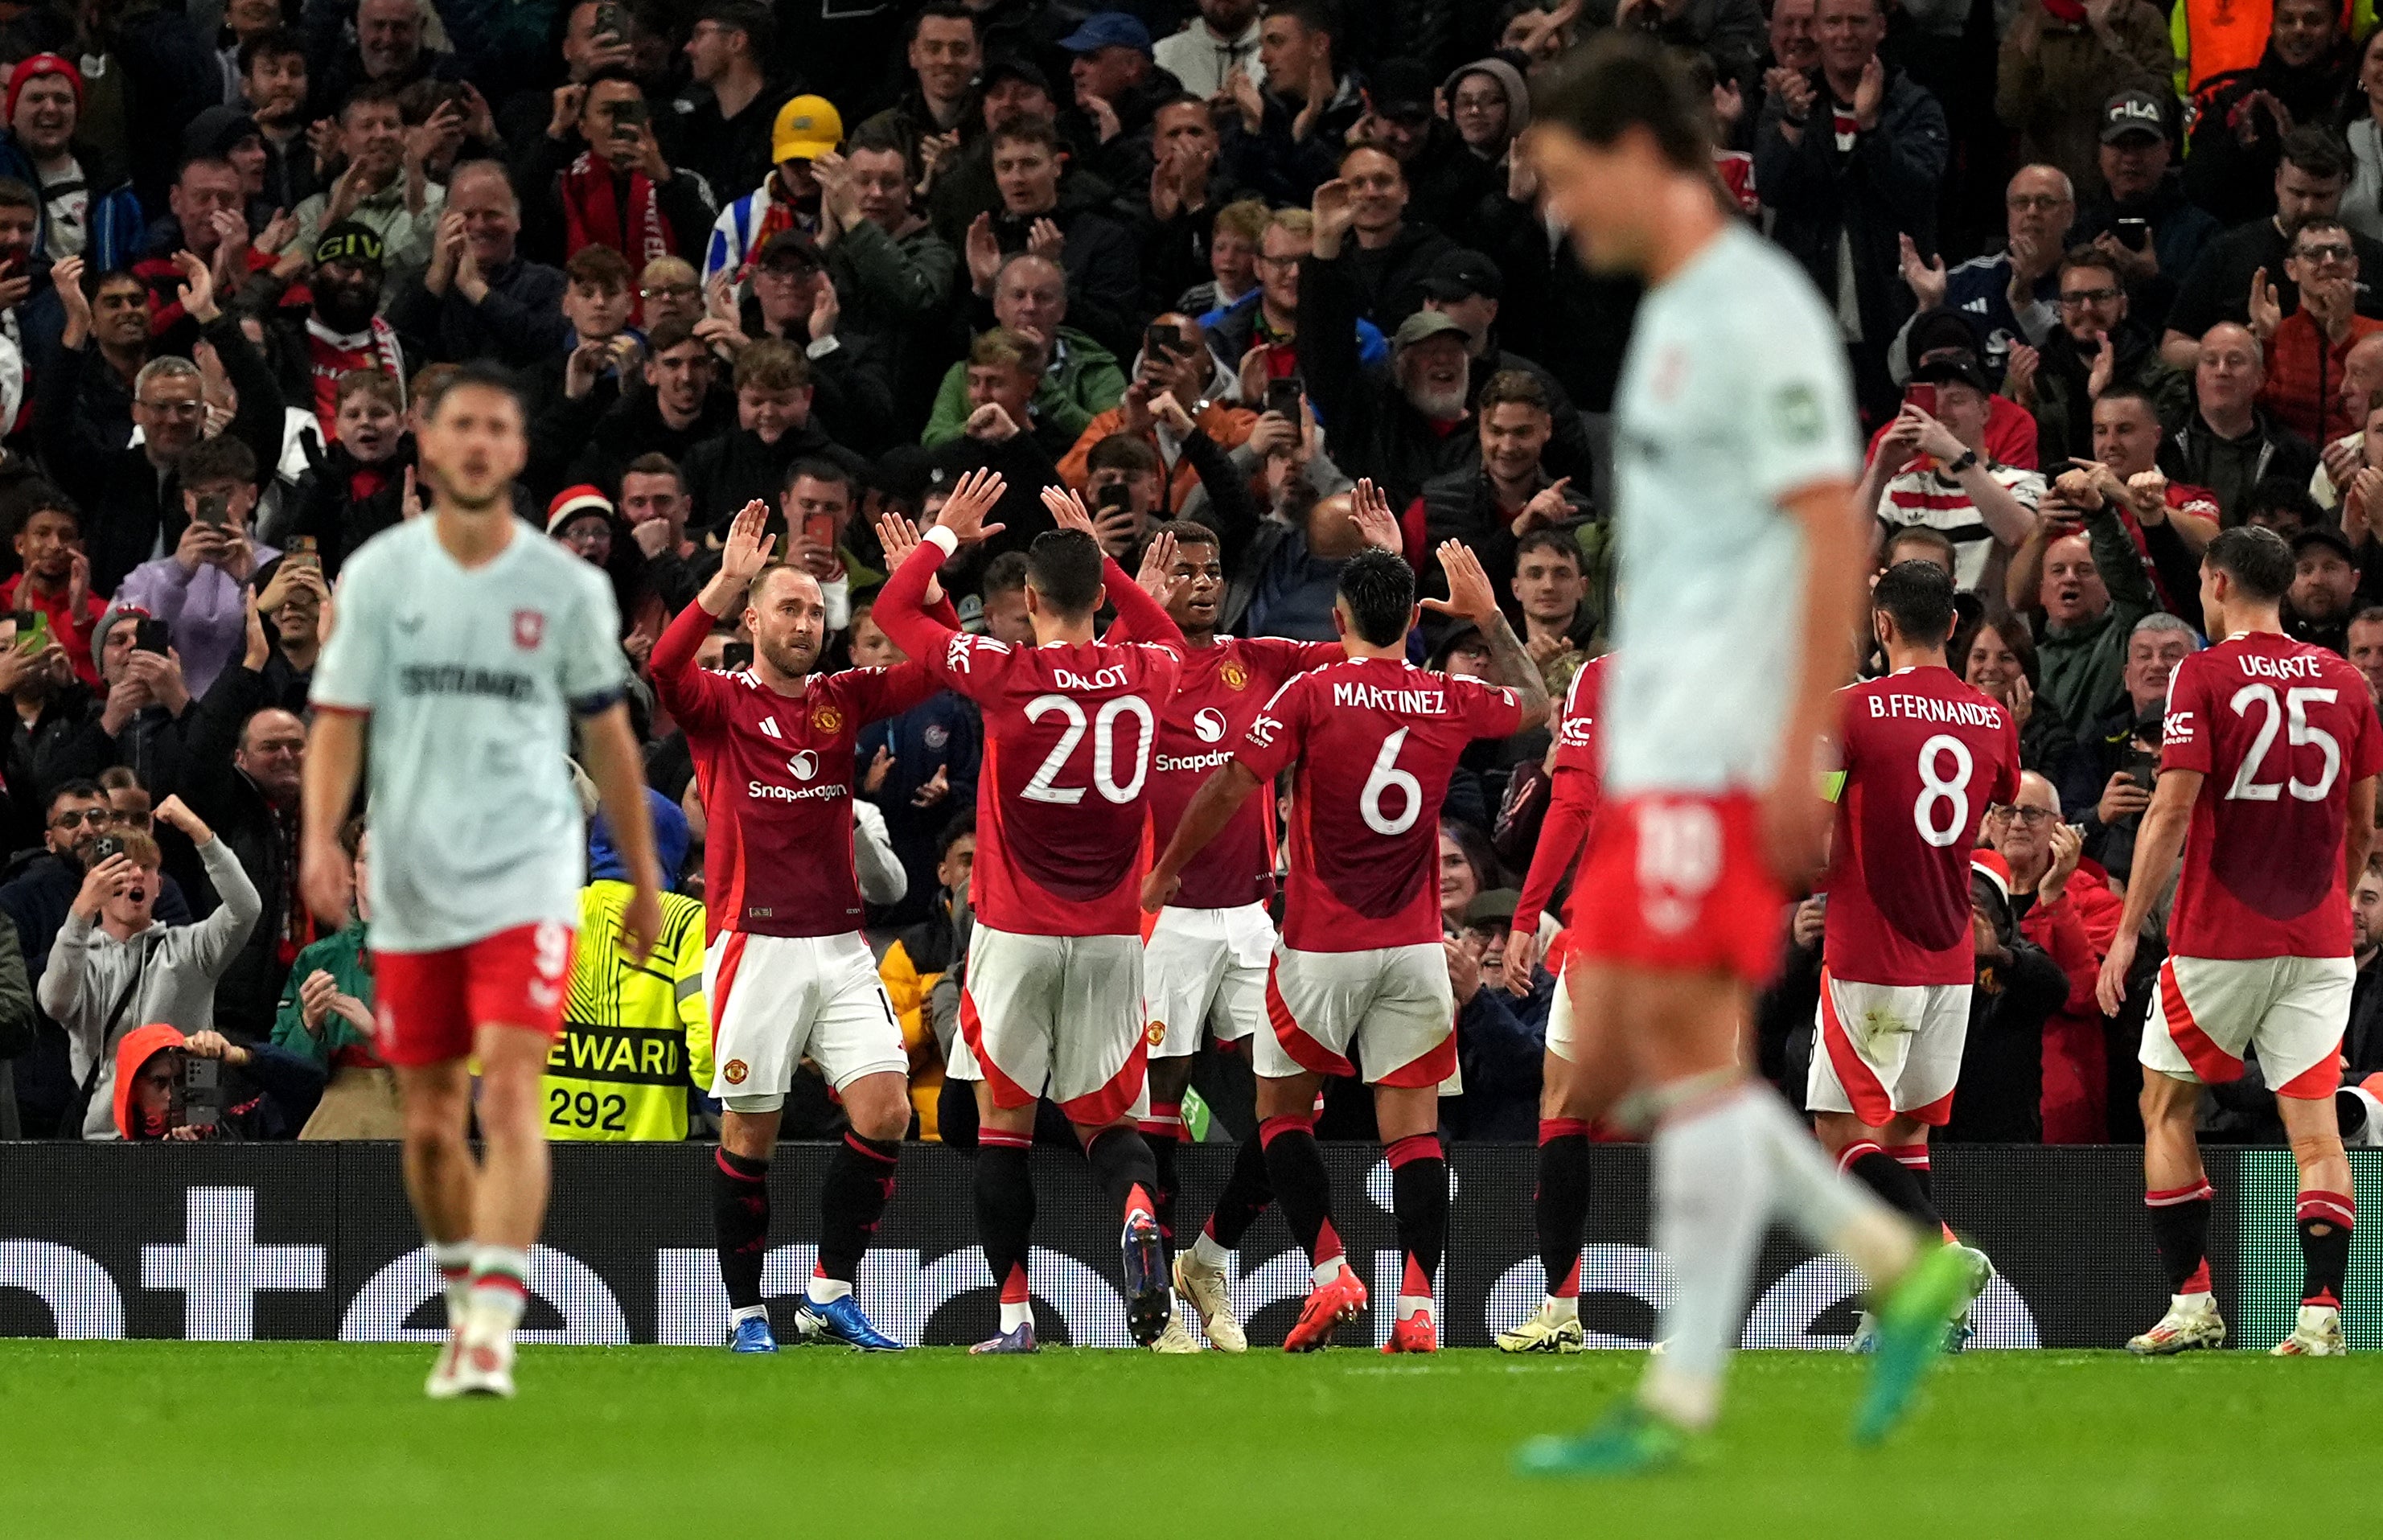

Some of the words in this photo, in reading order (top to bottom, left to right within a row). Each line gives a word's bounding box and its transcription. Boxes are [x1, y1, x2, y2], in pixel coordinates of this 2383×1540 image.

[2110, 100, 2160, 122] FILA
[1053, 663, 1128, 692] DALOT
[2237, 655, 2323, 680] UGARTE
[1333, 682, 1447, 714] MARTINEZ
[1867, 694, 2002, 730] B.FERNANDES
[2163, 712, 2194, 736] XC
[1019, 693, 1155, 805] 20
[2224, 683, 2341, 803] 25
[748, 780, 848, 803] Snapdragon
[1359, 725, 1423, 836] 6
[1913, 733, 1974, 848] 8
[549, 1087, 627, 1131] 292
